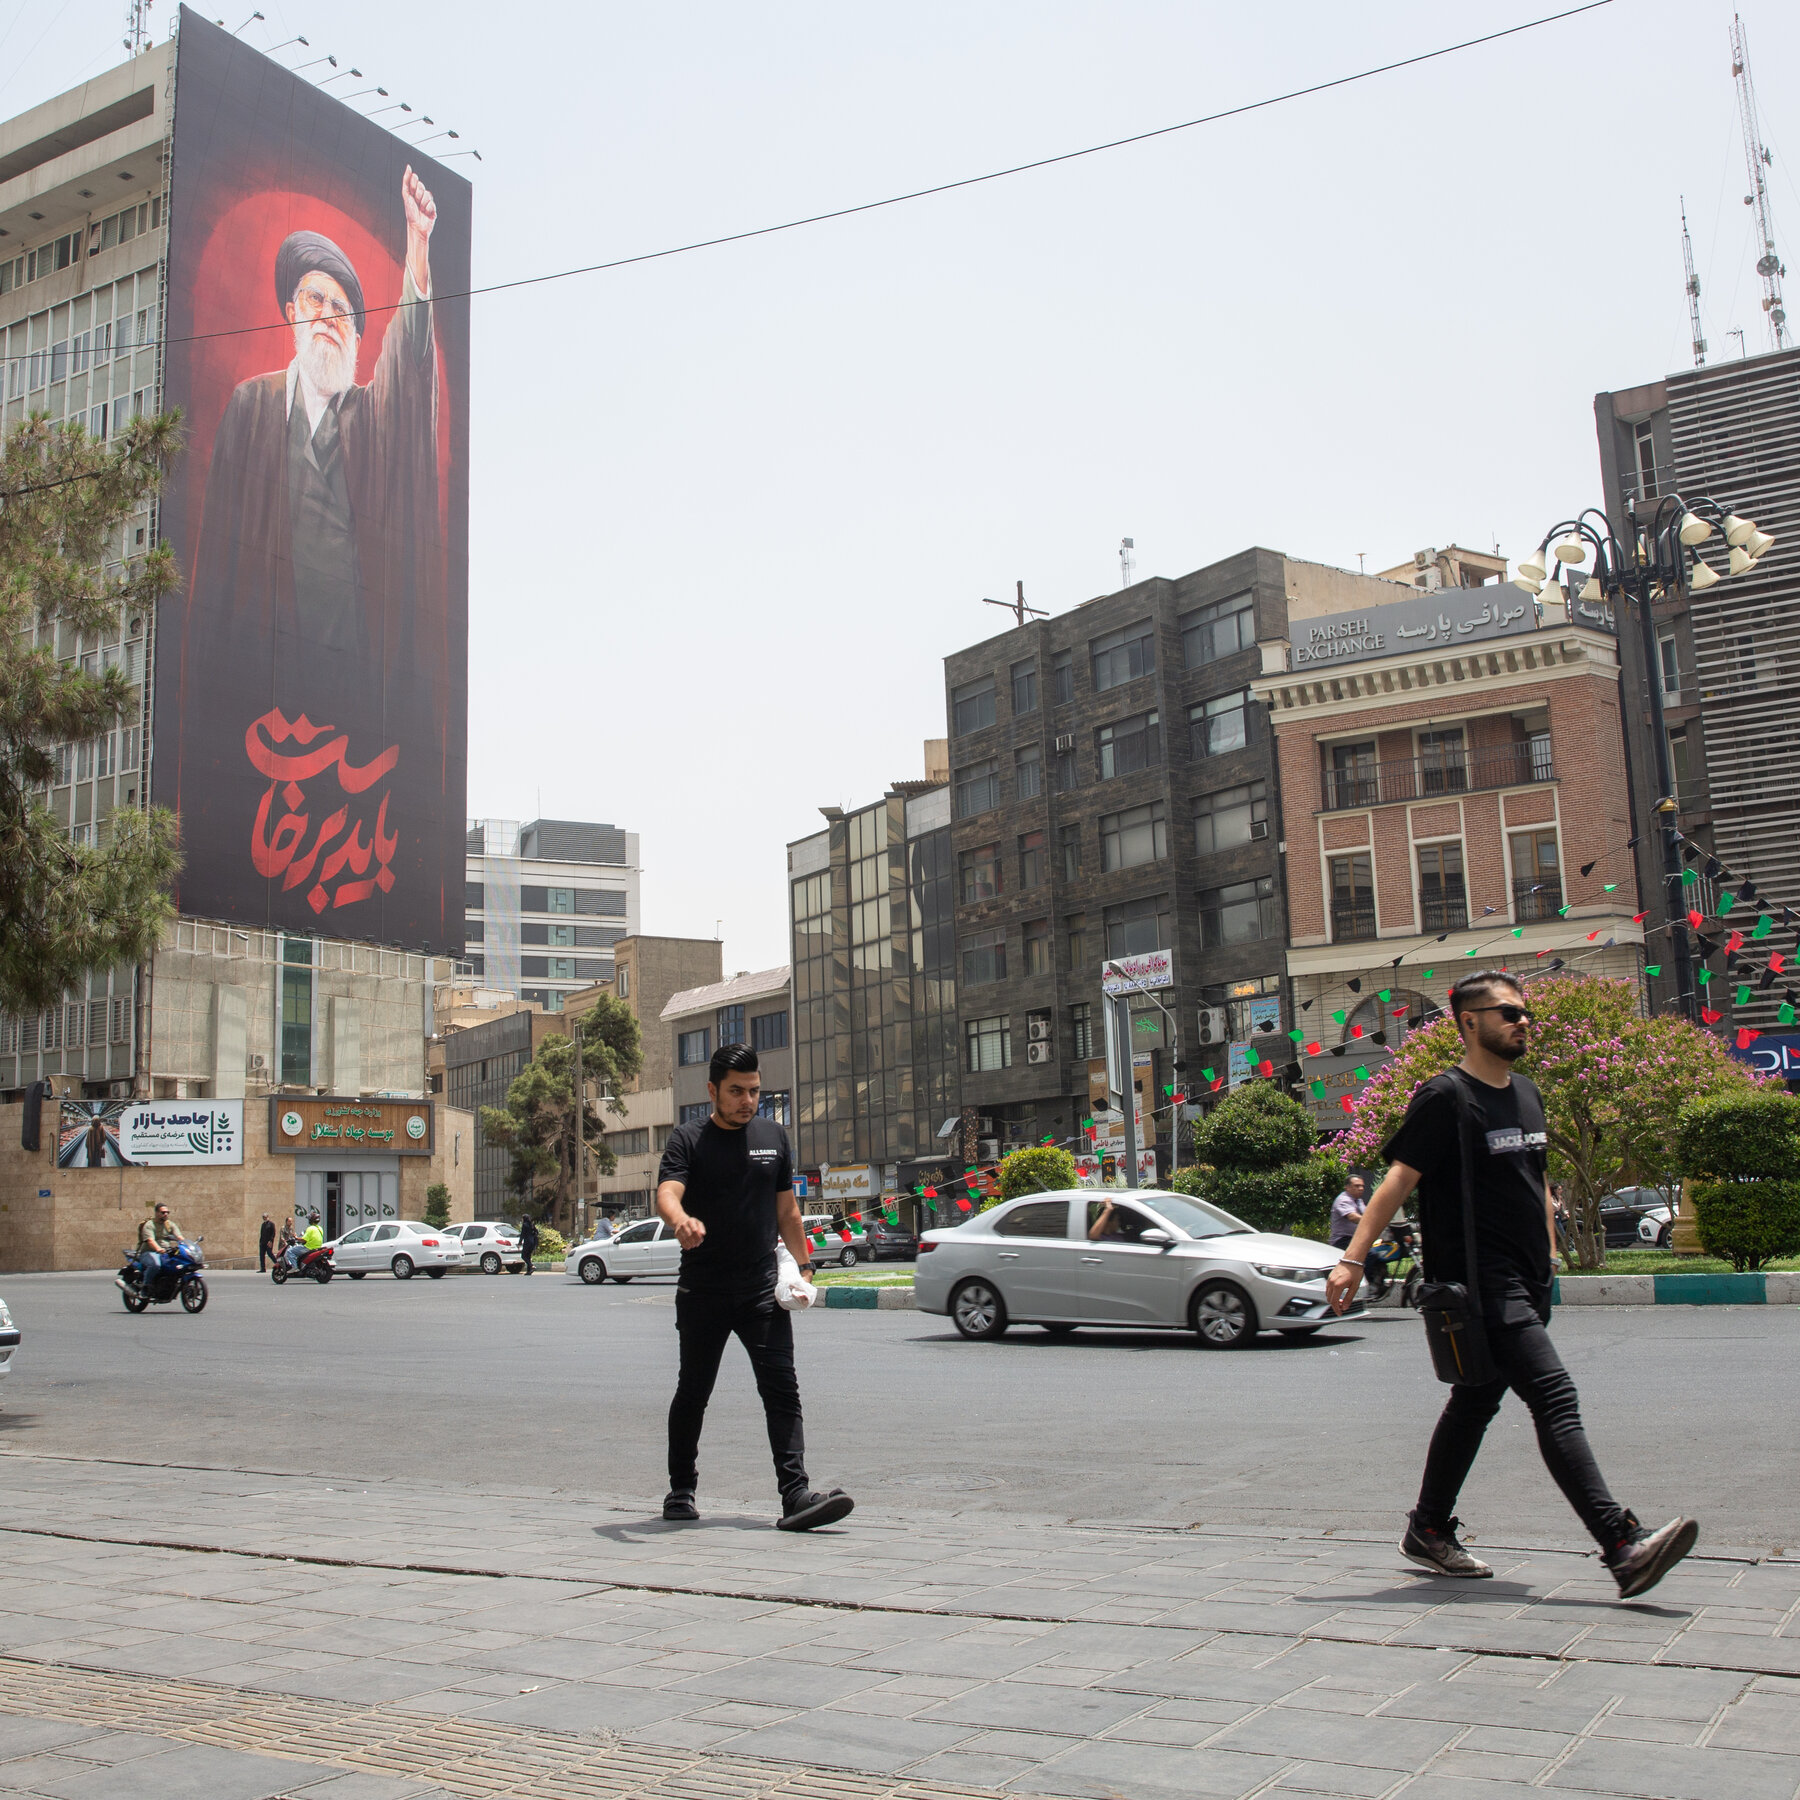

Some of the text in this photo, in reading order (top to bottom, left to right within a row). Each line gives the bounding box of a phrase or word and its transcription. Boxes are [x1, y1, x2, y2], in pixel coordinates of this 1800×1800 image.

[1309, 618, 1369, 643] PARSEH
[1397, 601, 1525, 641] صرافی پارسه
[1297, 633, 1385, 663] EXCHANGE
[132, 1112, 209, 1129] جاهد بازار
[350, 1107, 363, 1118] جهاد
[131, 1131, 160, 1141] مستقیم
[310, 1121, 395, 1143] موسسه جهاد استقلال
[852, 1174, 869, 1188] سکه
